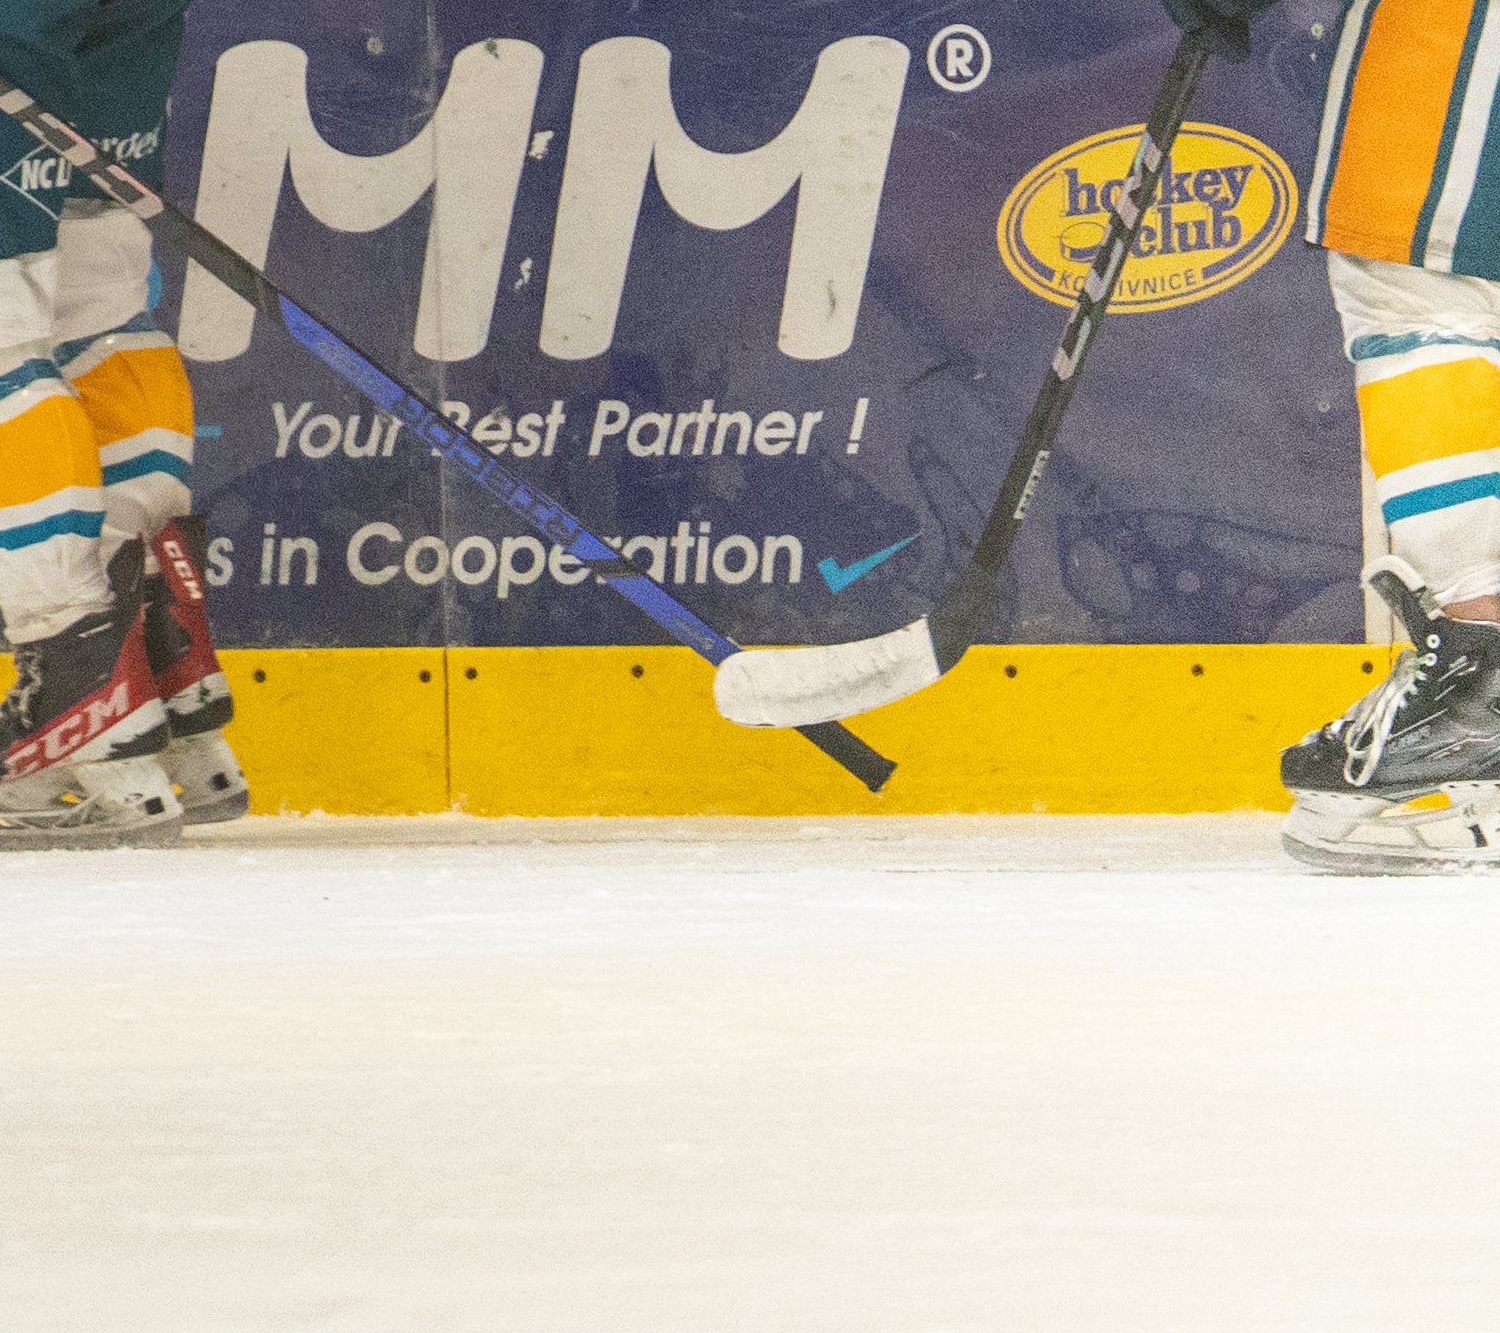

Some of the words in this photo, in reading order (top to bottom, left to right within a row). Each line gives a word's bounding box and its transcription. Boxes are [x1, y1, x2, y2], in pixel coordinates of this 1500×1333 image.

[1062, 162, 1254, 219] hokey
[1134, 201, 1242, 259] club
[1058, 268, 1198, 297] KOIVNICE
[270, 400, 403, 459] Your
[588, 400, 823, 457] Partner
[846, 398, 870, 455] !
[260, 524, 318, 587] in
[346, 521, 804, 599] Coopeation
[5, 682, 132, 779] CCM
